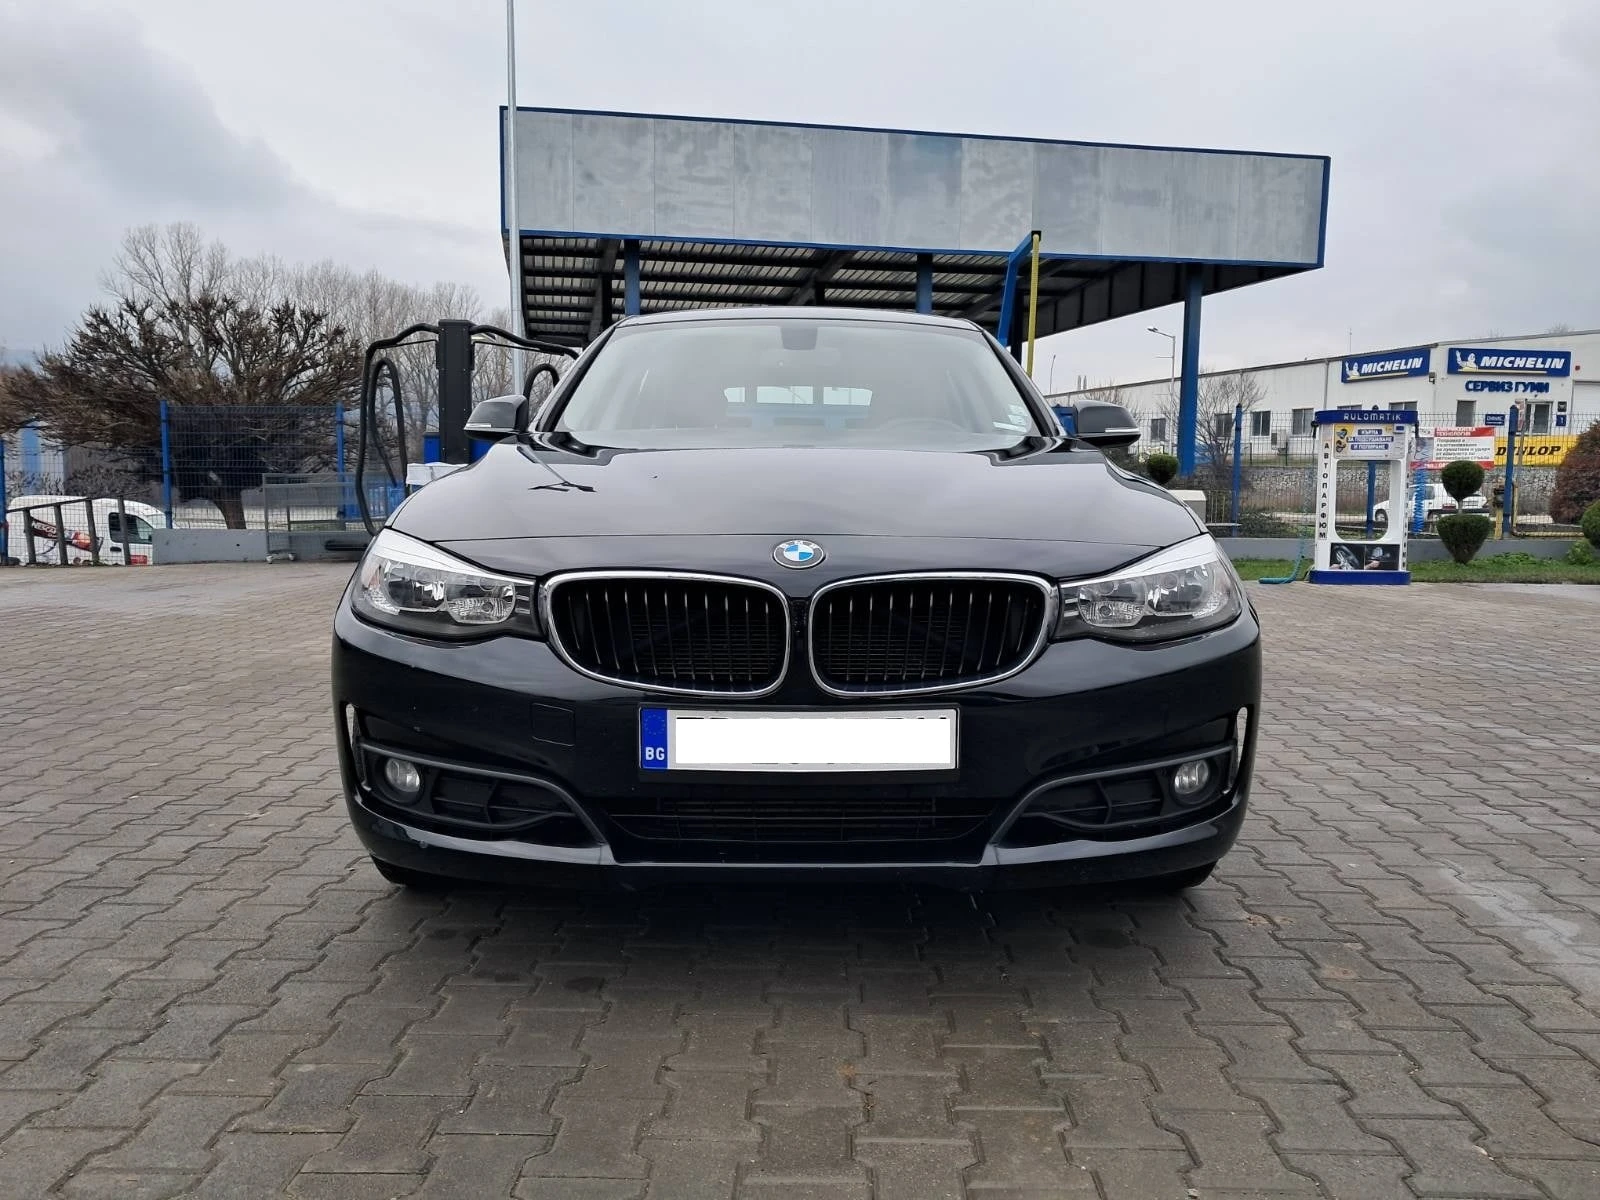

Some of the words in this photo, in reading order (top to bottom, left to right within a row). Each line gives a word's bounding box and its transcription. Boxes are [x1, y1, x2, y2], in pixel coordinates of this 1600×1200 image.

[1361, 357, 1423, 374] MICHELIN
[1480, 356, 1565, 369] MICHELIN
[1465, 380, 1513, 392] СЕРВИЗ
[1514, 381, 1550, 393] ГУМИ
[1495, 445, 1561, 456] DNLOP
[1319, 442, 1330, 539] АВТОПАРФЮМ
[645, 747, 665, 761] BG
